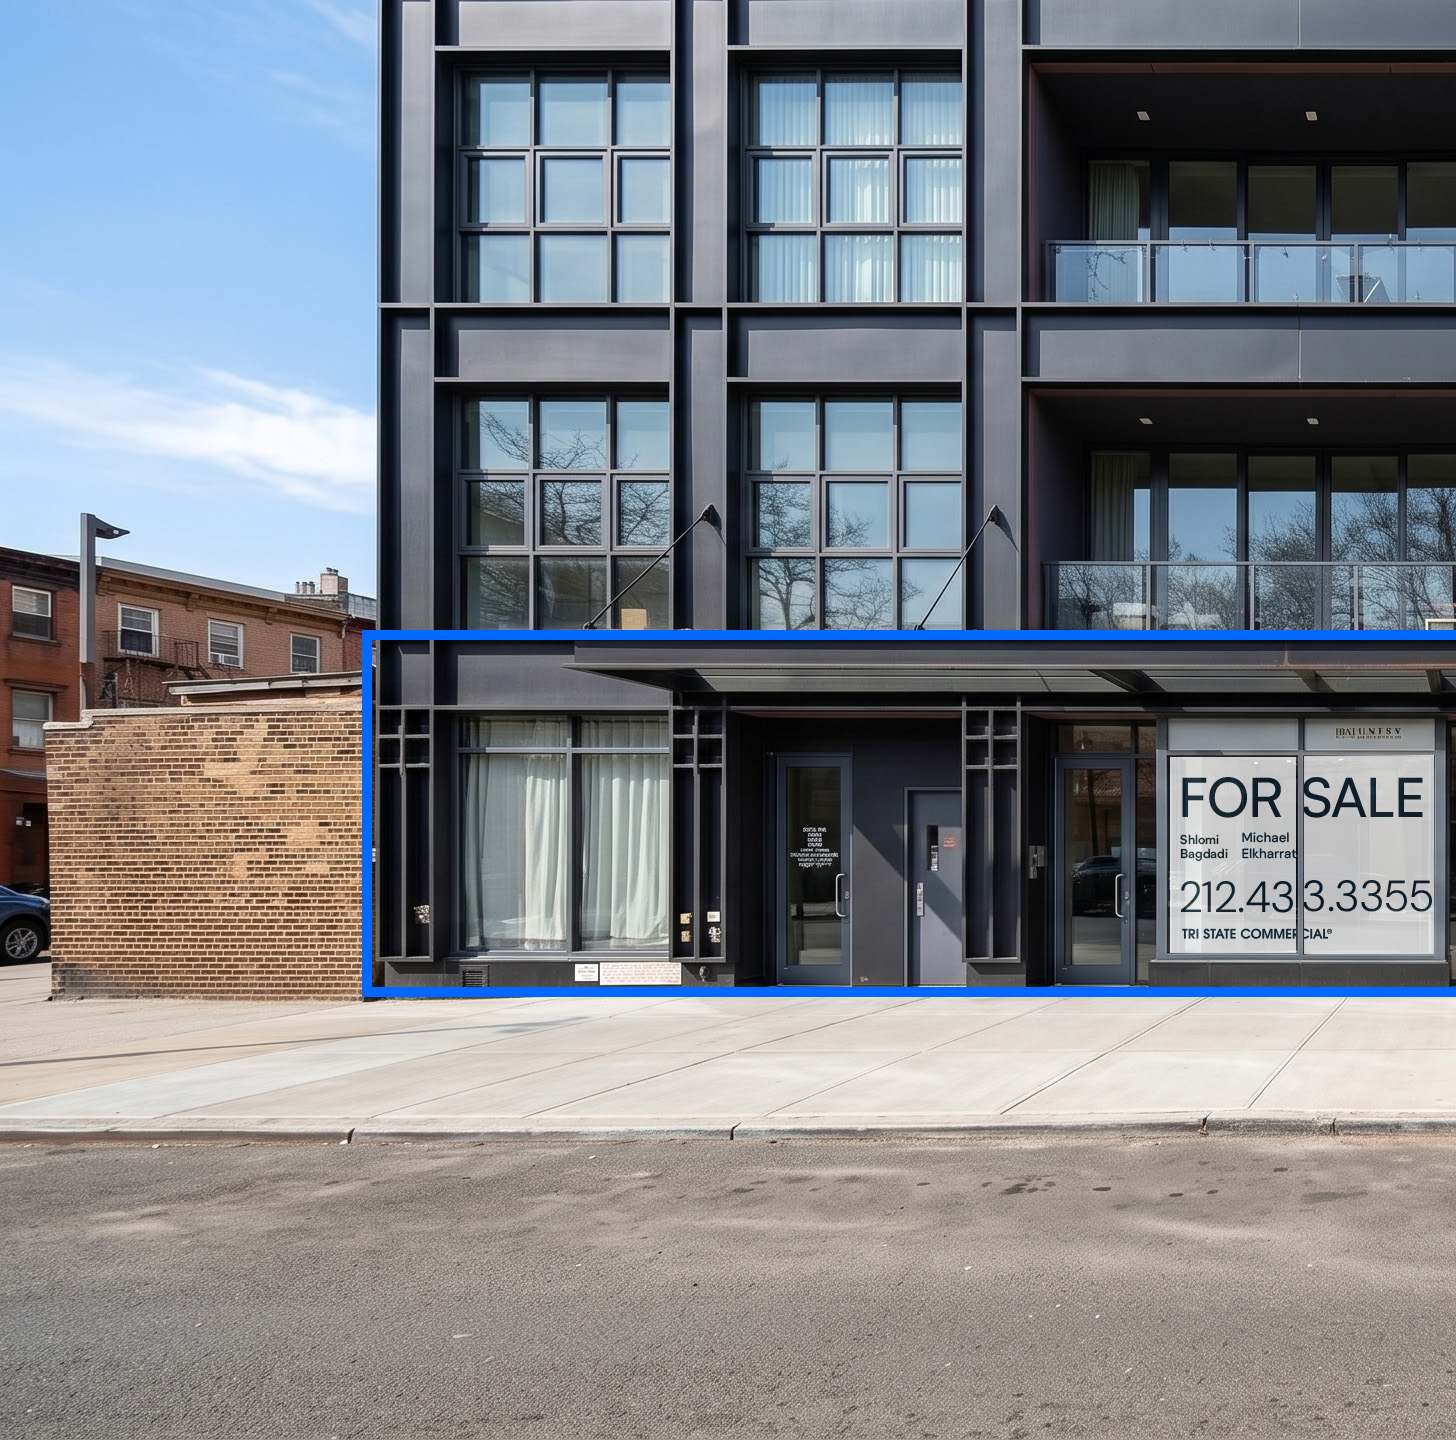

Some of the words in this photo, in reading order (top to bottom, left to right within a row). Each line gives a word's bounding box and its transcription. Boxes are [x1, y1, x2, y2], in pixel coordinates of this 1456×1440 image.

[1181, 776, 1282, 818] FOR
[1303, 776, 1424, 818] SALE
[1180, 834, 1219, 845] Shlomi
[1241, 832, 1290, 843] Michael
[1180, 848, 1229, 862] Bagdadi
[1241, 848, 1298, 859] Elkharrat
[1180, 880, 1433, 913] 212.433.3355
[1182, 928, 1199, 939] TRI
[1203, 928, 1237, 939] STATE
